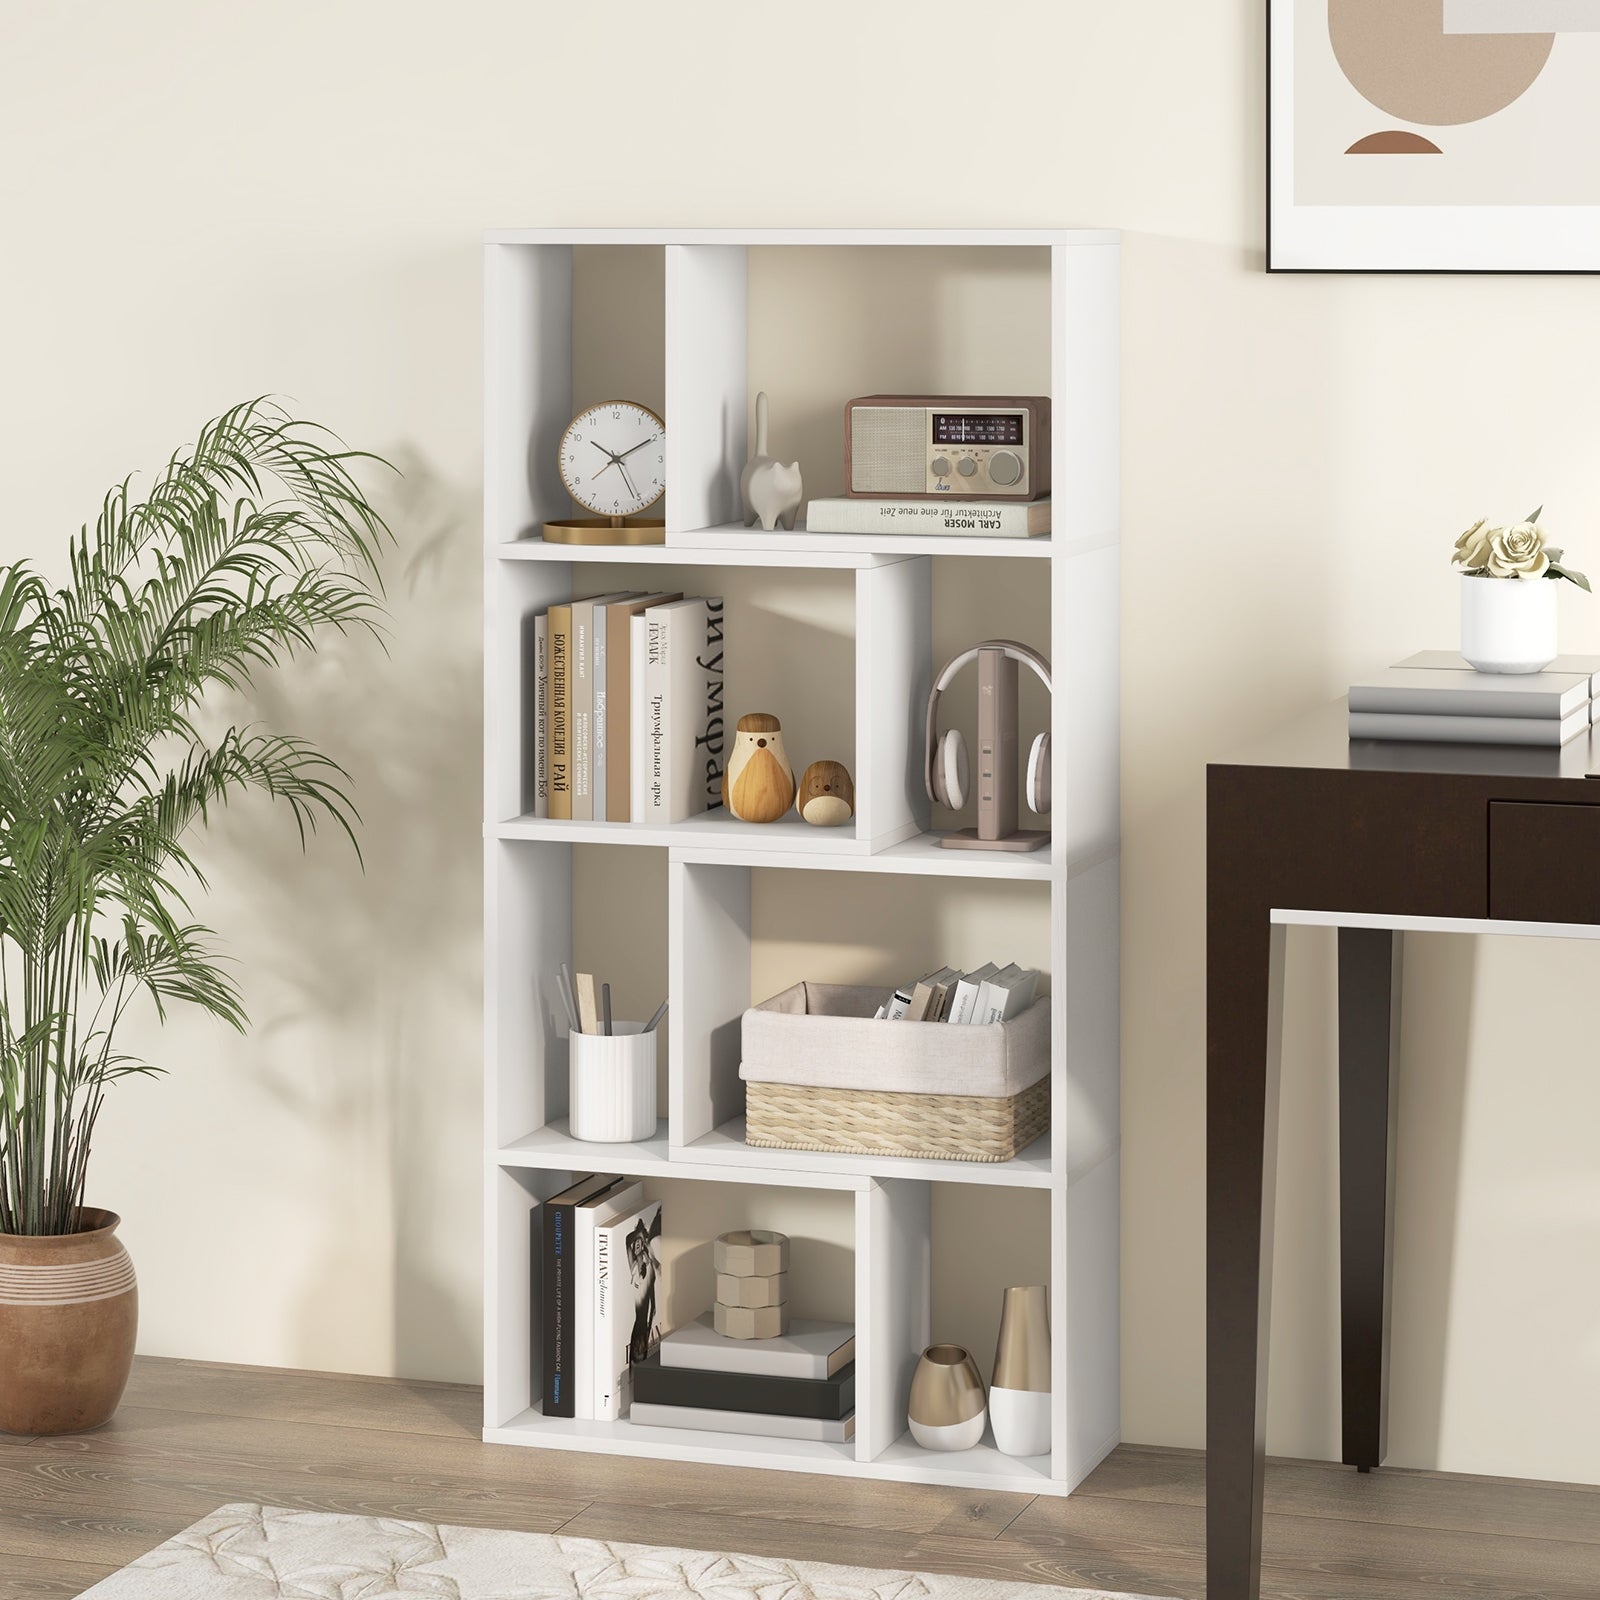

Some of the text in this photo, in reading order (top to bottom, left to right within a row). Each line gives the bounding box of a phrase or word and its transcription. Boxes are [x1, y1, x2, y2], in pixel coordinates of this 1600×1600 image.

[570, 455, 574, 463] 9
[637, 493, 641, 501] 5
[880, 507, 896, 516] Zeit
[941, 509, 952, 518] für
[955, 509, 1001, 519] Architektur
[945, 519, 1001, 528] CARL MOSER
[538, 676, 547, 716] Уличный
[553, 634, 566, 755] БОЖЕСТВЕННАЯ КОМЕДИЯ
[594, 691, 605, 748] Избранное
[539, 736, 546, 748] по
[651, 694, 663, 807] Триумфальная арка
[538, 749, 546, 779] имени
[554, 763, 569, 792] РАЙ
[538, 780, 547, 798] Боб
